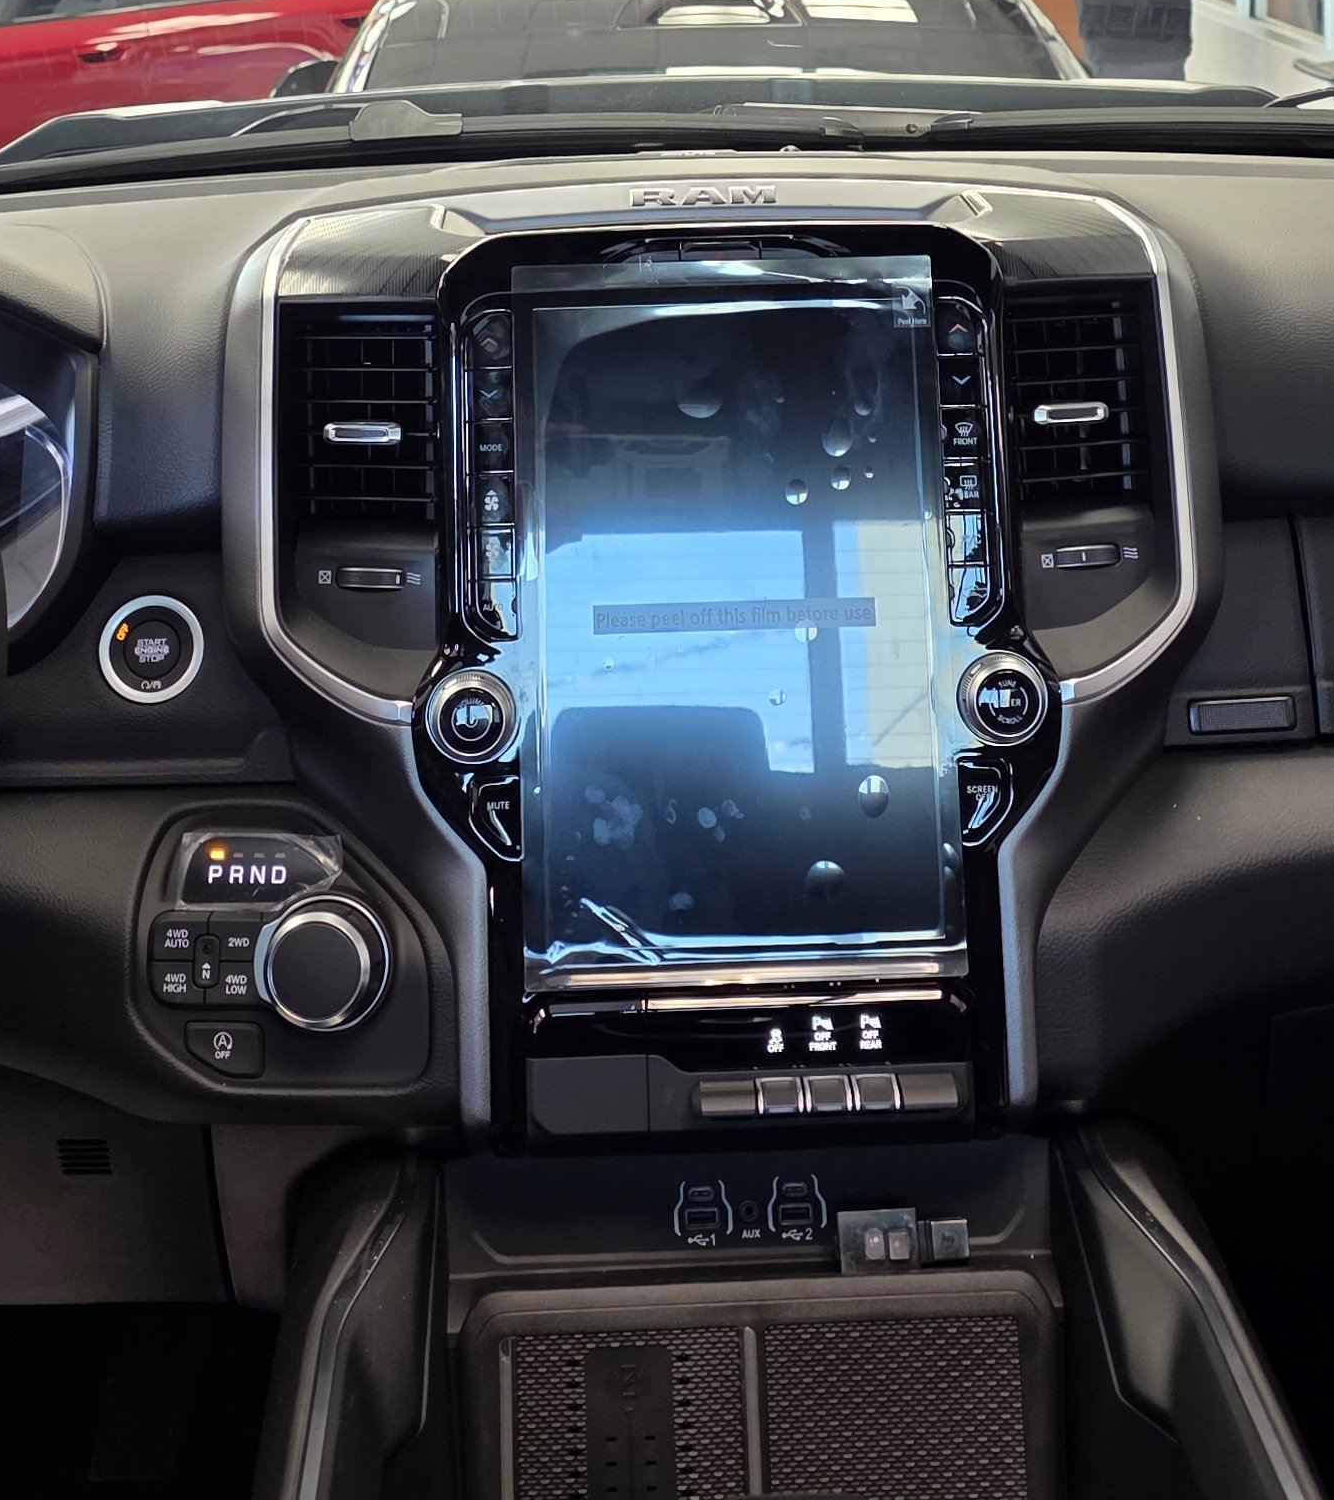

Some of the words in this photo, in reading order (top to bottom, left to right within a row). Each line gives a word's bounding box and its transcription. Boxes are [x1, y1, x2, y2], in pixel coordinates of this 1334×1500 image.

[629, 185, 777, 207] RAM
[897, 316, 911, 326] Peel
[912, 316, 928, 326] Here
[952, 437, 978, 446] FRONT
[479, 443, 503, 453] MODE
[959, 490, 980, 499] EAR
[483, 603, 504, 612] AUTO
[595, 611, 646, 629] Please
[651, 610, 685, 630] peel
[690, 607, 714, 626] off
[716, 606, 746, 625] this
[750, 604, 781, 624] film
[786, 603, 839, 623] before
[843, 608, 872, 620] use
[116, 622, 130, 641] OFF
[137, 637, 168, 647] START
[134, 645, 170, 656] ENGINE
[139, 654, 166, 664] STOP
[998, 679, 1017, 689] TUNE
[997, 713, 1023, 725] SCROLL
[966, 785, 999, 794] SCREEN
[486, 801, 511, 811] MUTE
[165, 929, 189, 939] 4WD
[163, 938, 190, 949] AUTO
[227, 937, 251, 948] 2WD
[164, 973, 187, 983] 4WD
[201, 969, 211, 980] N
[224, 975, 248, 985] 4WD
[162, 982, 187, 993] HIGH
[225, 984, 247, 995] LOW
[813, 1030, 832, 1042] OFF
[861, 1029, 880, 1040] OFF
[766, 1043, 785, 1054] OFF
[808, 1041, 838, 1052] FRONT
[858, 1039, 883, 1050] REAR
[214, 1050, 232, 1060] OFF
[741, 1228, 762, 1240] AUX
[804, 1226, 815, 1241] 2
[709, 1232, 717, 1247] 1
